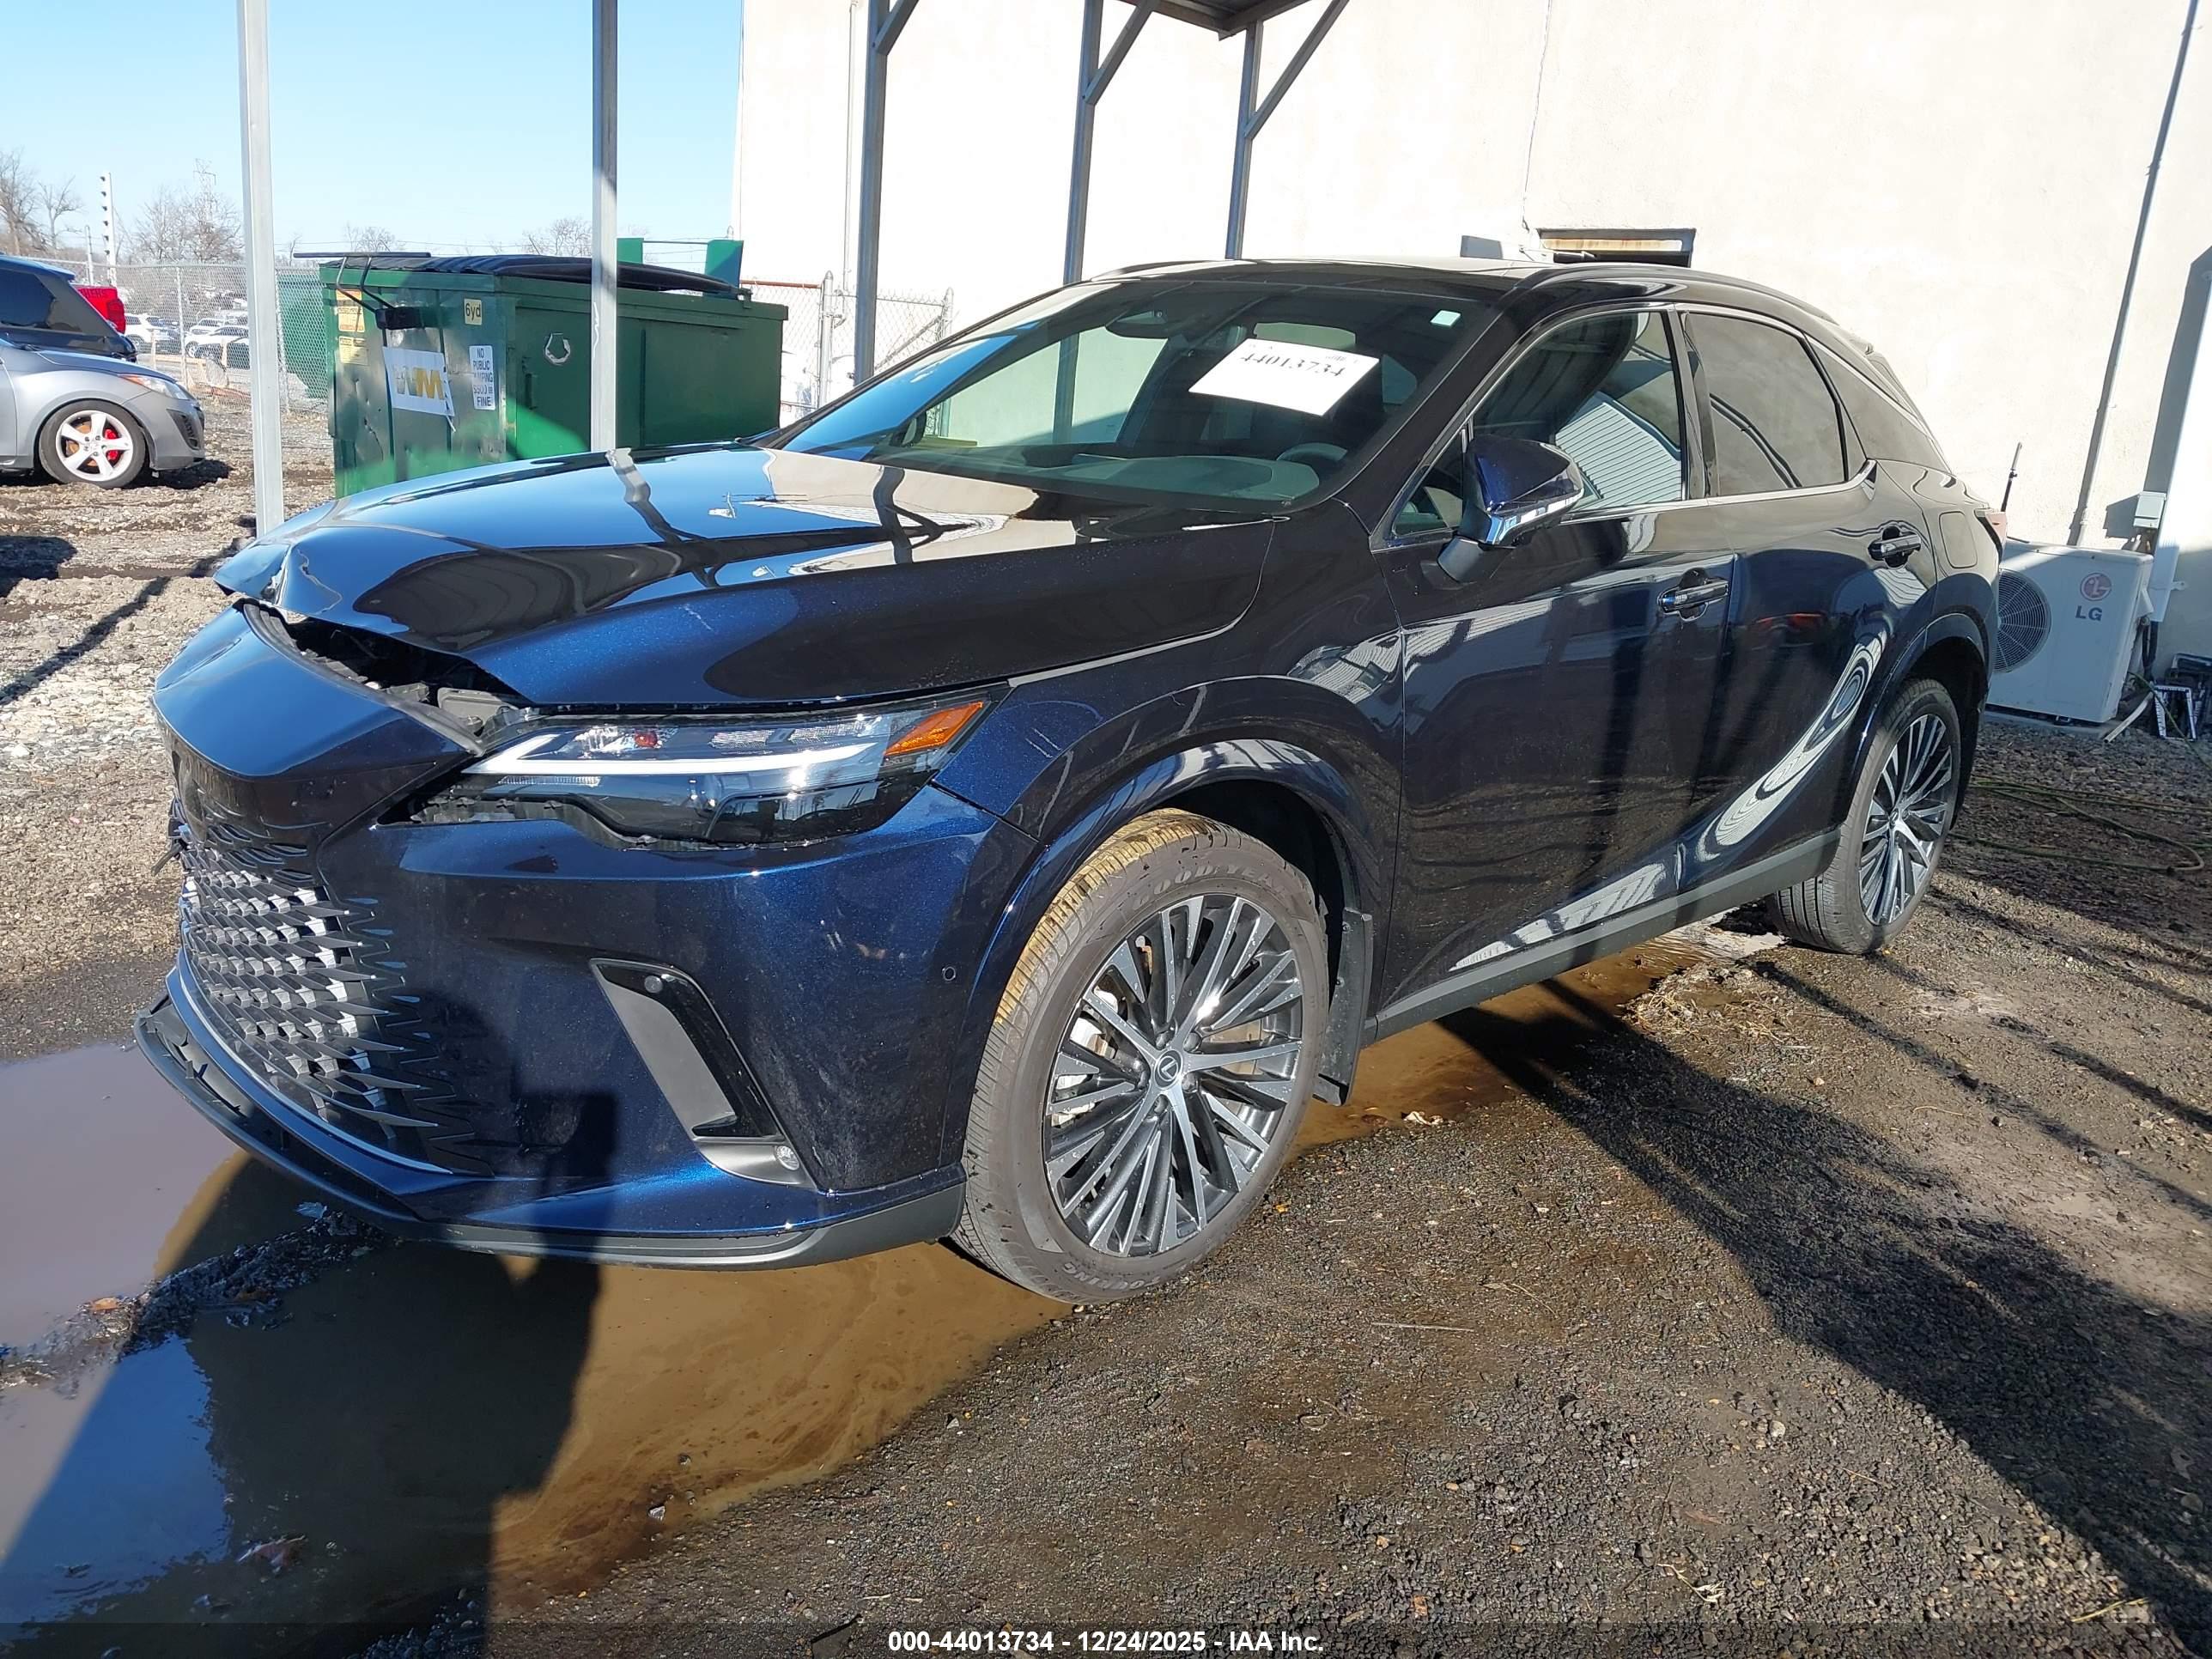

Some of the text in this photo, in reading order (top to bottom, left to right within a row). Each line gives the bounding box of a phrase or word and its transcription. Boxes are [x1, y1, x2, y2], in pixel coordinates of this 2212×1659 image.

[465, 303, 482, 320] 6yd
[477, 348, 485, 358] NO
[473, 360, 490, 370] PUBLIC
[1241, 353, 1346, 376] 44013734
[477, 397, 492, 407] FINE
[2075, 605, 2103, 621] LG
